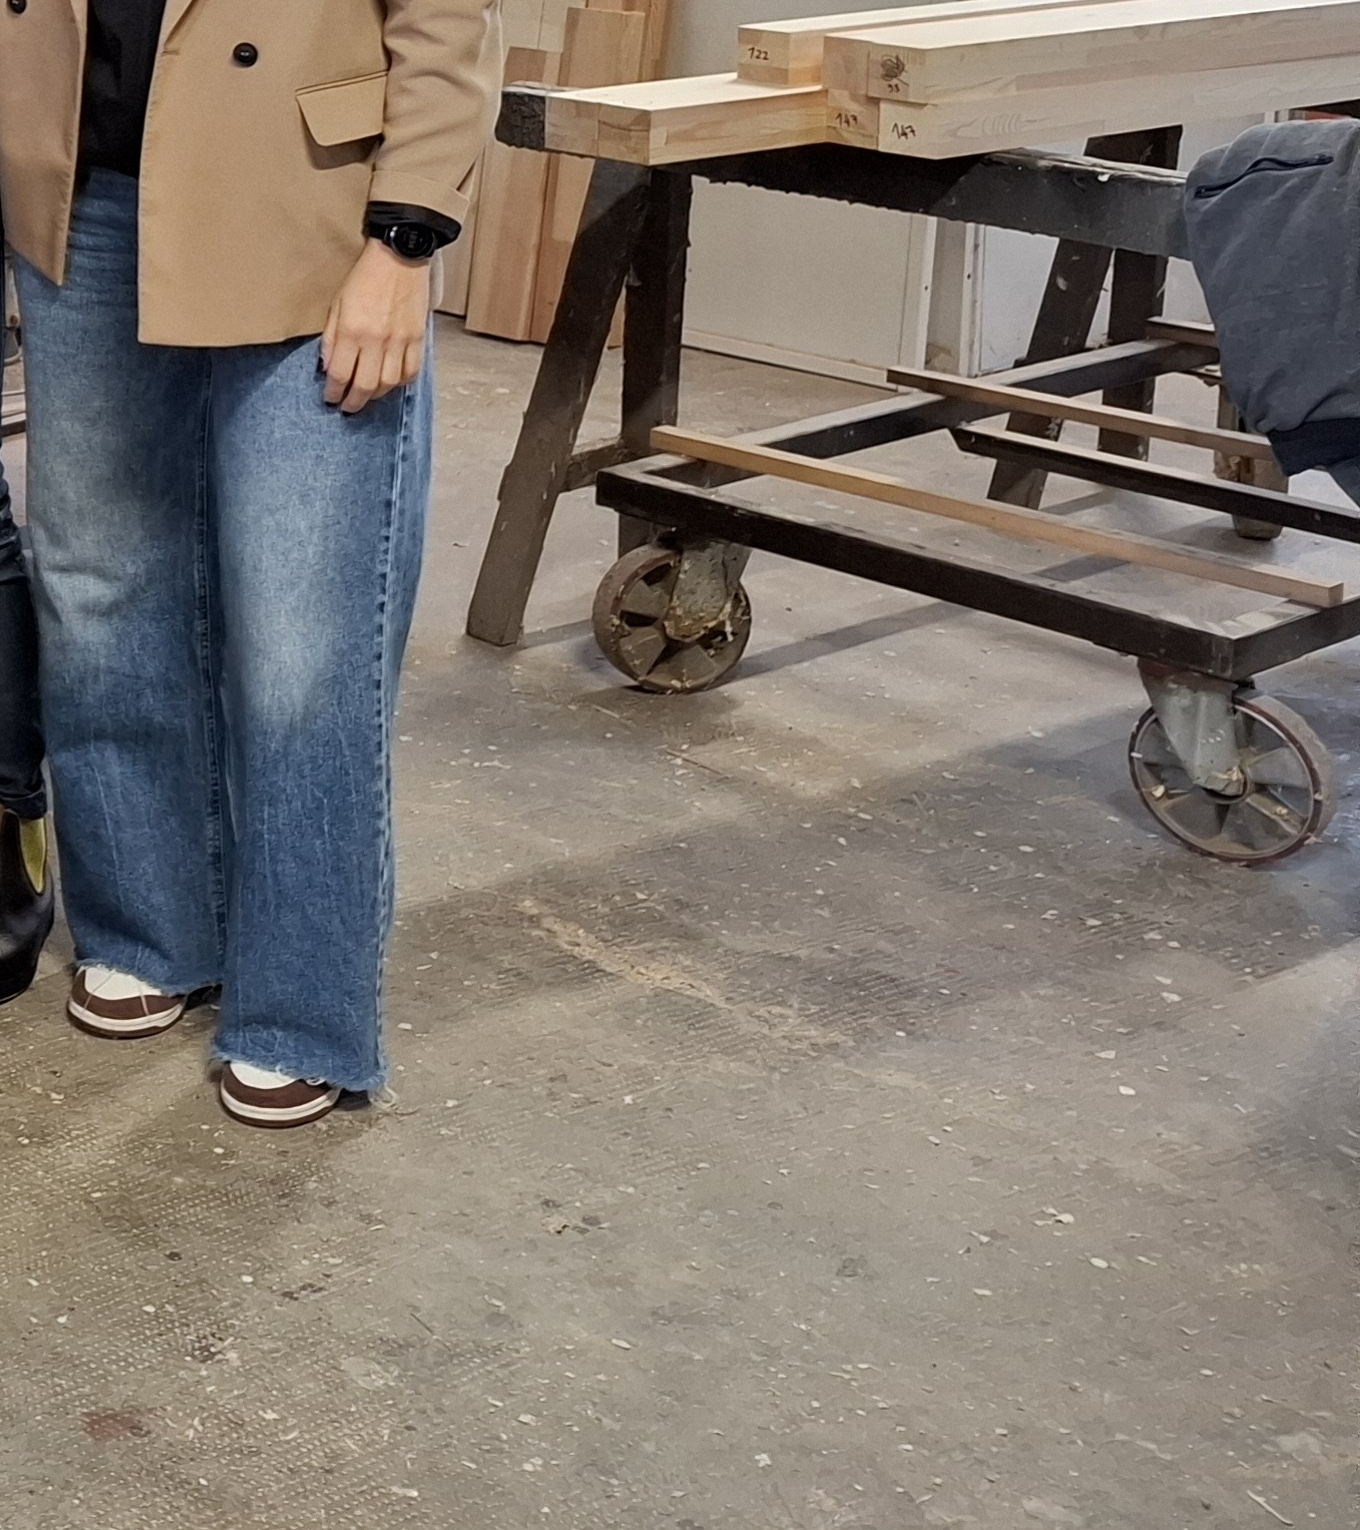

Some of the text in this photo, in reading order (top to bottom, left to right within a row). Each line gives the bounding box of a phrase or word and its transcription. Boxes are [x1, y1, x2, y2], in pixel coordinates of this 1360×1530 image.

[747, 46, 770, 61] 122
[835, 112, 858, 128] 147
[891, 122, 917, 140] 147
